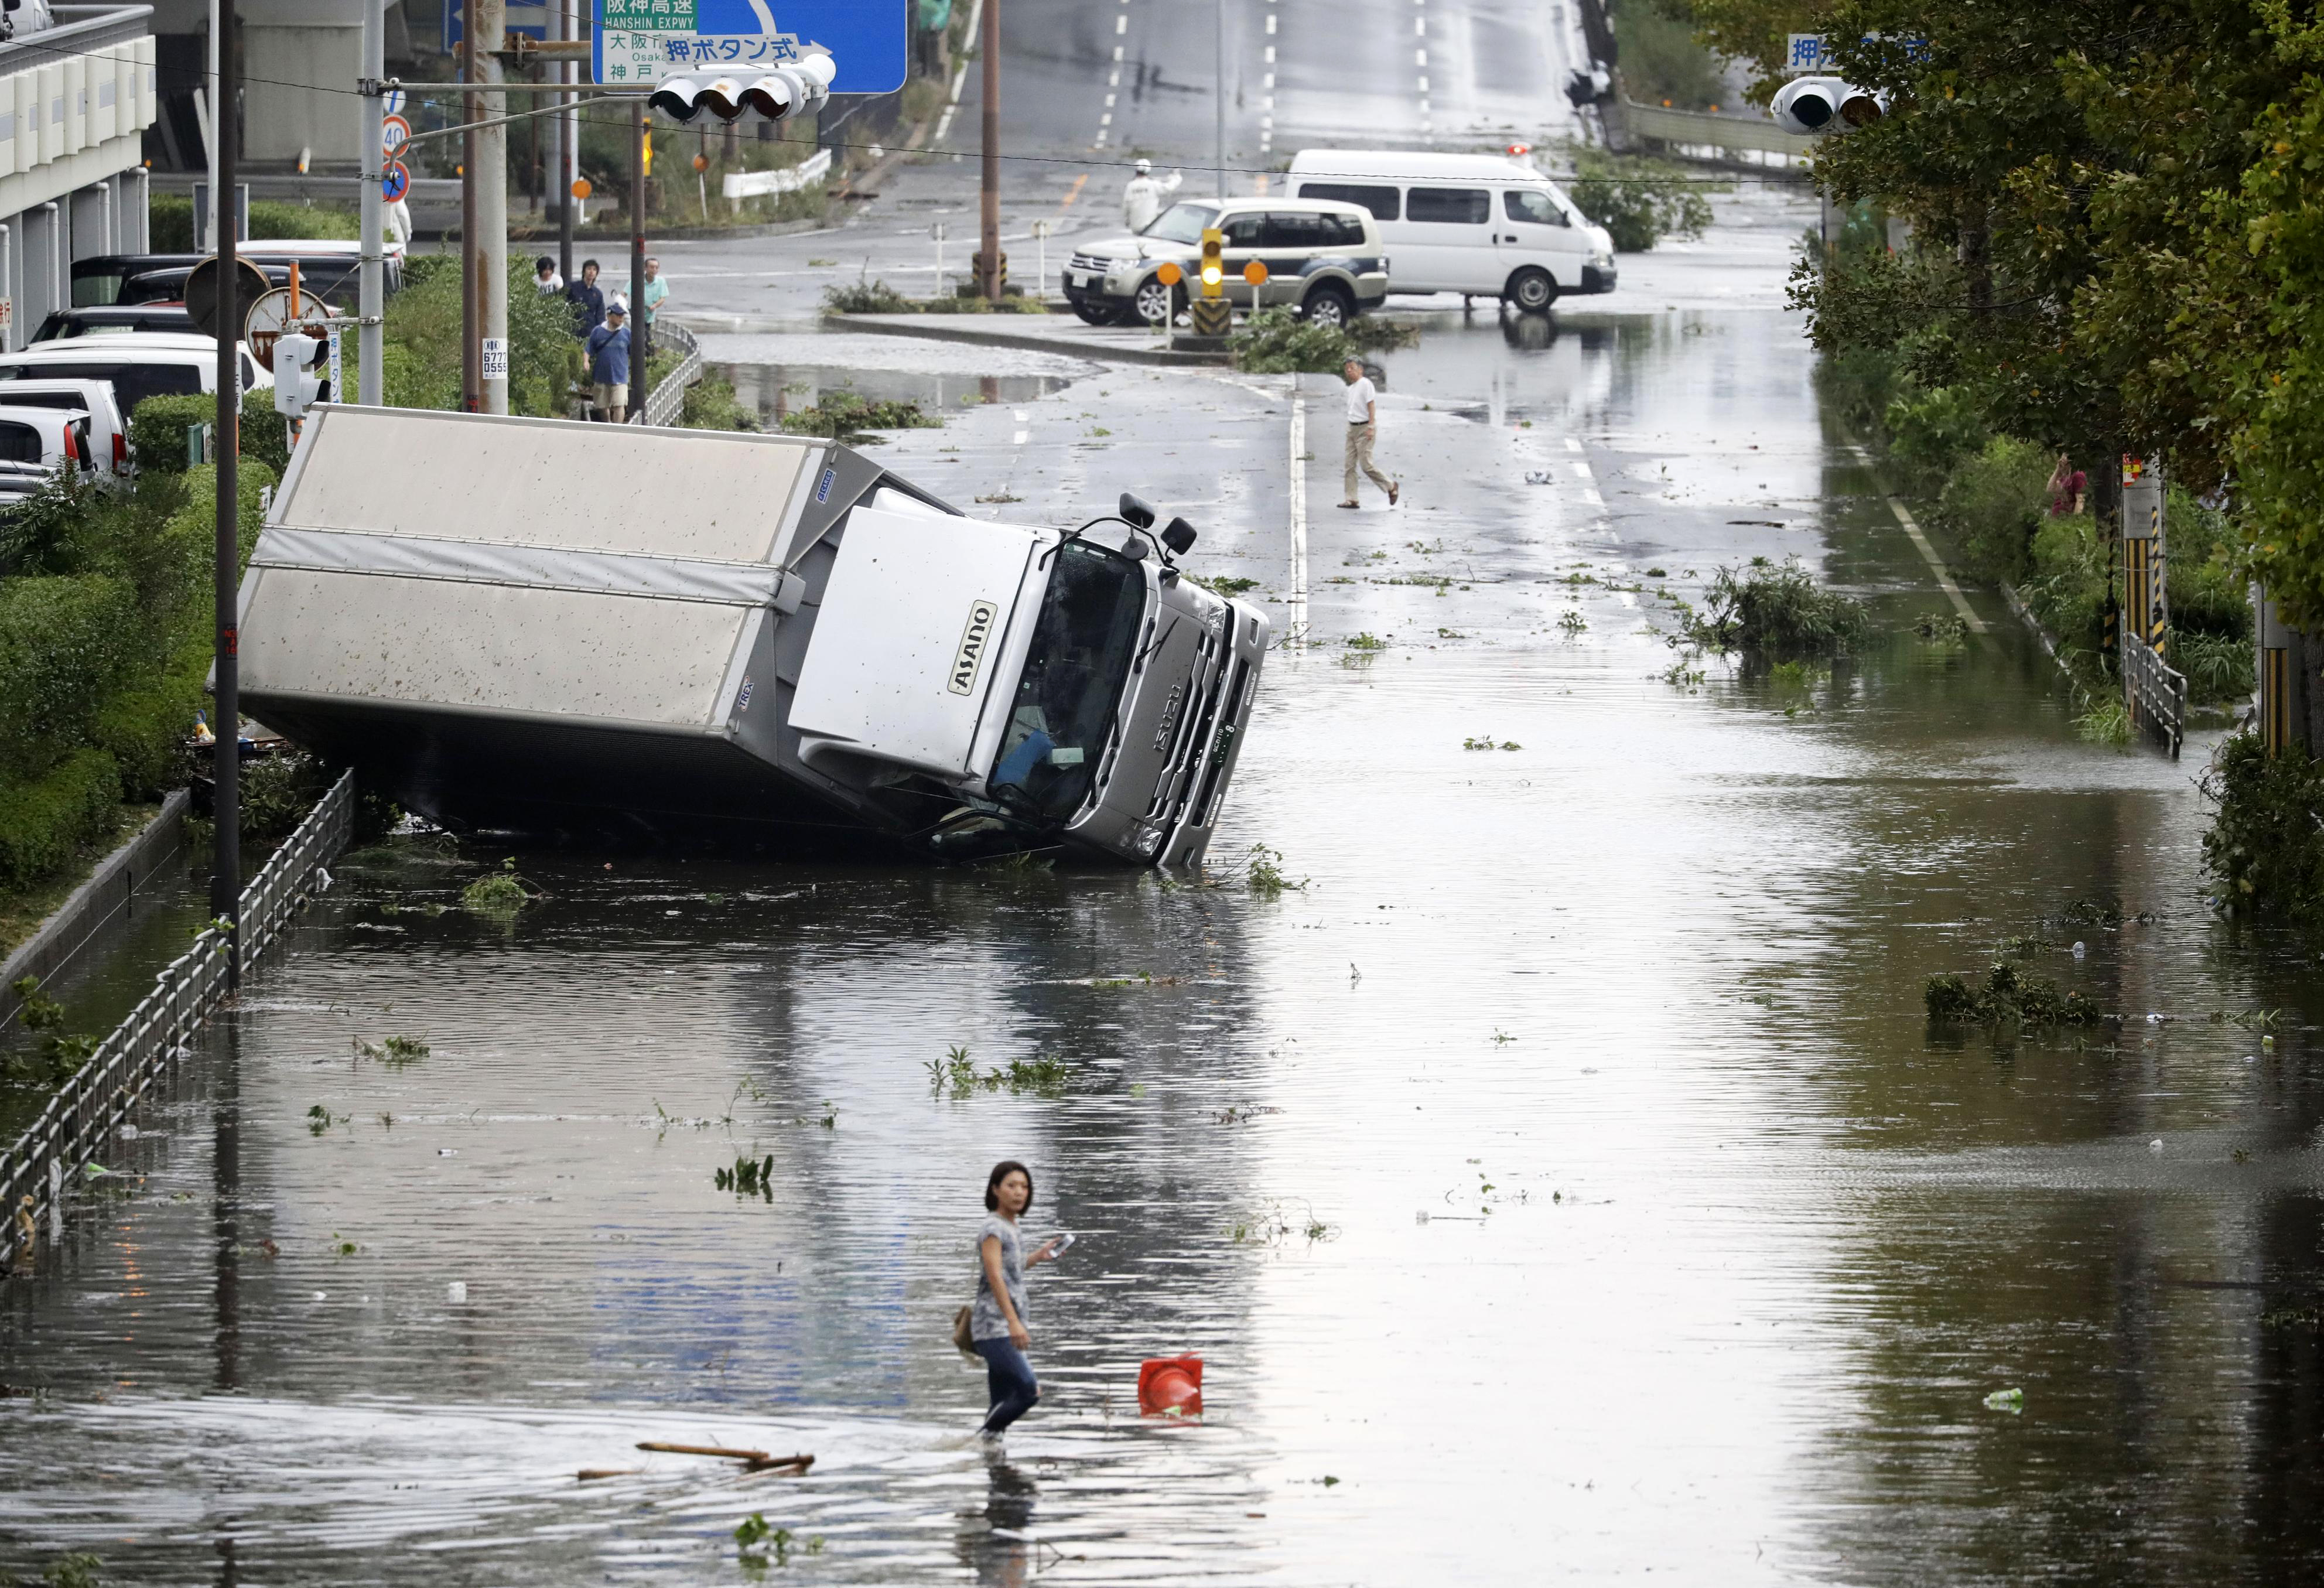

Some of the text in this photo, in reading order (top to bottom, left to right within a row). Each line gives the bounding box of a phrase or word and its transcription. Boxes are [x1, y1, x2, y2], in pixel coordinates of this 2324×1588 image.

[607, 0, 693, 14] 阪神高速
[606, 17, 694, 29] HANSHIN EXPWY
[665, 37, 798, 61] 押ボタン式
[610, 64, 652, 80] 神戸
[385, 128, 403, 146] 40
[821, 472, 832, 491] CARGO
[955, 607, 990, 688] ASANO
[739, 684, 753, 706] TREX
[1153, 684, 1181, 750] ISUZU
